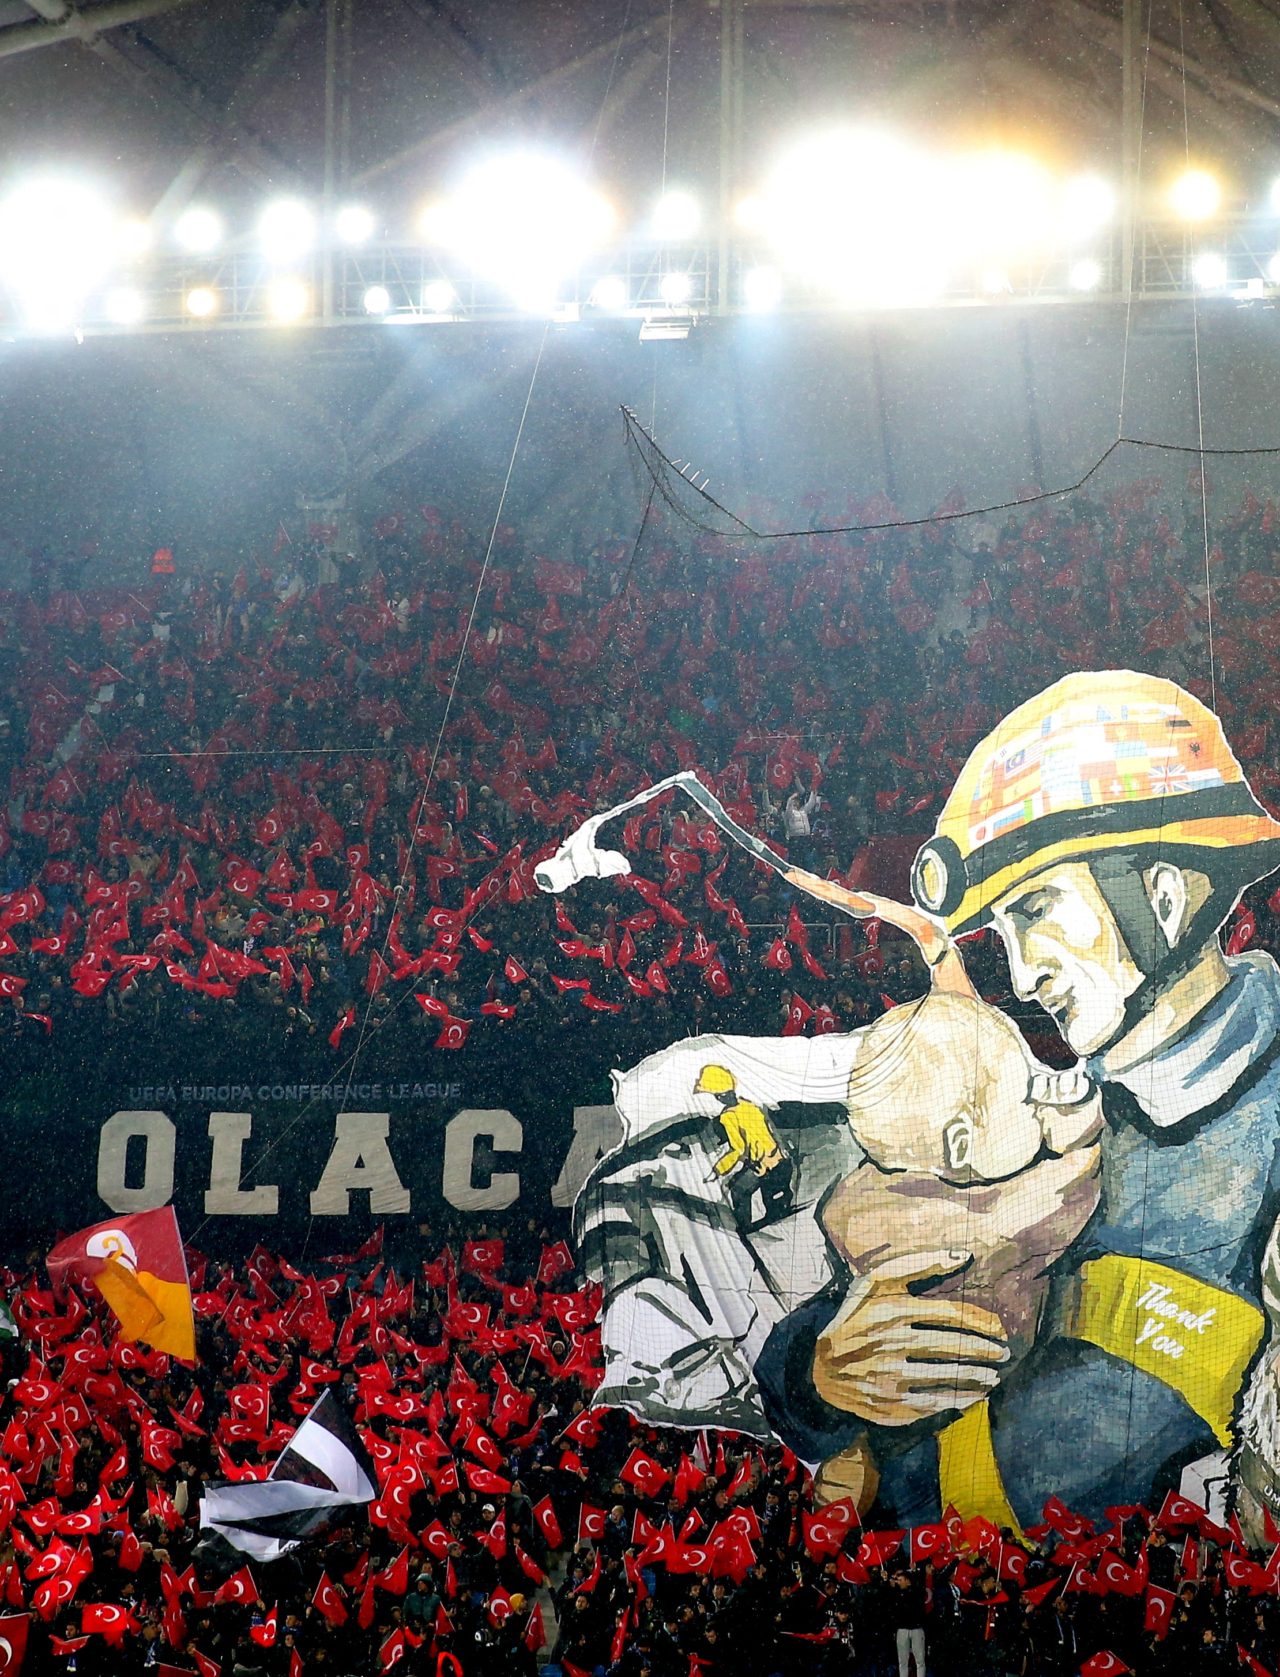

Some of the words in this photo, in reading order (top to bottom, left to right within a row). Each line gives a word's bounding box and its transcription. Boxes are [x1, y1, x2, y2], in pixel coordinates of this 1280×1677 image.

[129, 1086, 177, 1101] UEFA
[182, 1085, 253, 1101] EUROPA
[257, 1084, 382, 1101] CONFERENCE
[388, 1083, 462, 1099] LEAGUE
[1136, 1280, 1217, 1334] Thank
[1136, 1317, 1185, 1359] You
